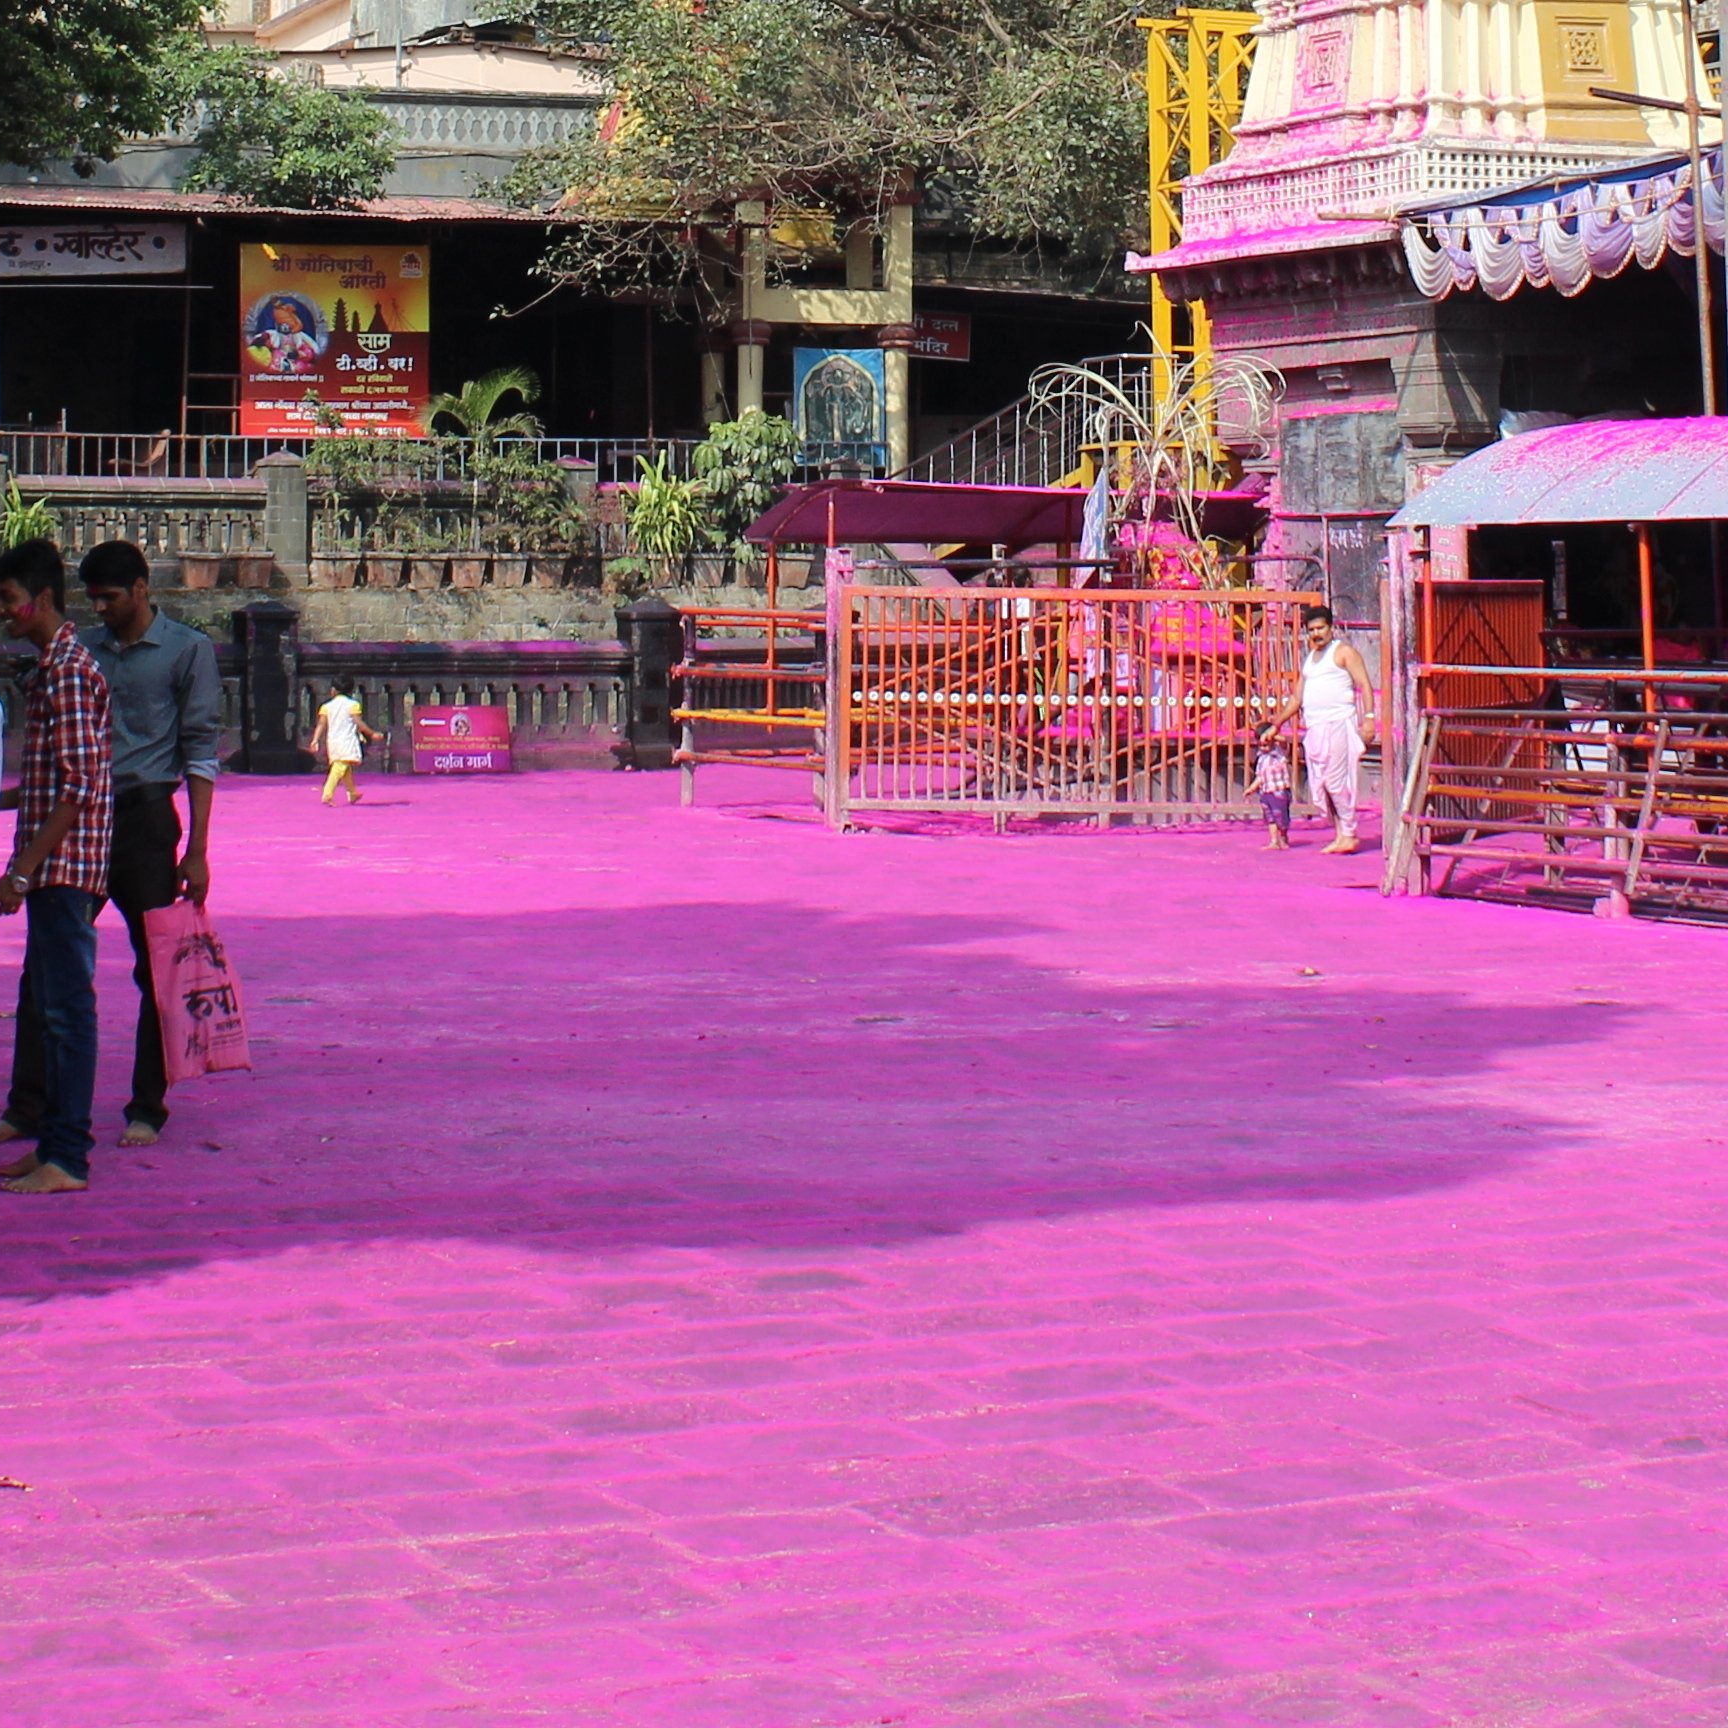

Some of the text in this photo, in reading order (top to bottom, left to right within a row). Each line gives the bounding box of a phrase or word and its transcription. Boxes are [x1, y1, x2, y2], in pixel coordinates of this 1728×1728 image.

[339, 271, 387, 289] आरती
[357, 333, 392, 354] साम
[913, 336, 949, 355] मंदिर
[433, 752, 493, 769] दर्शन मार्ग
